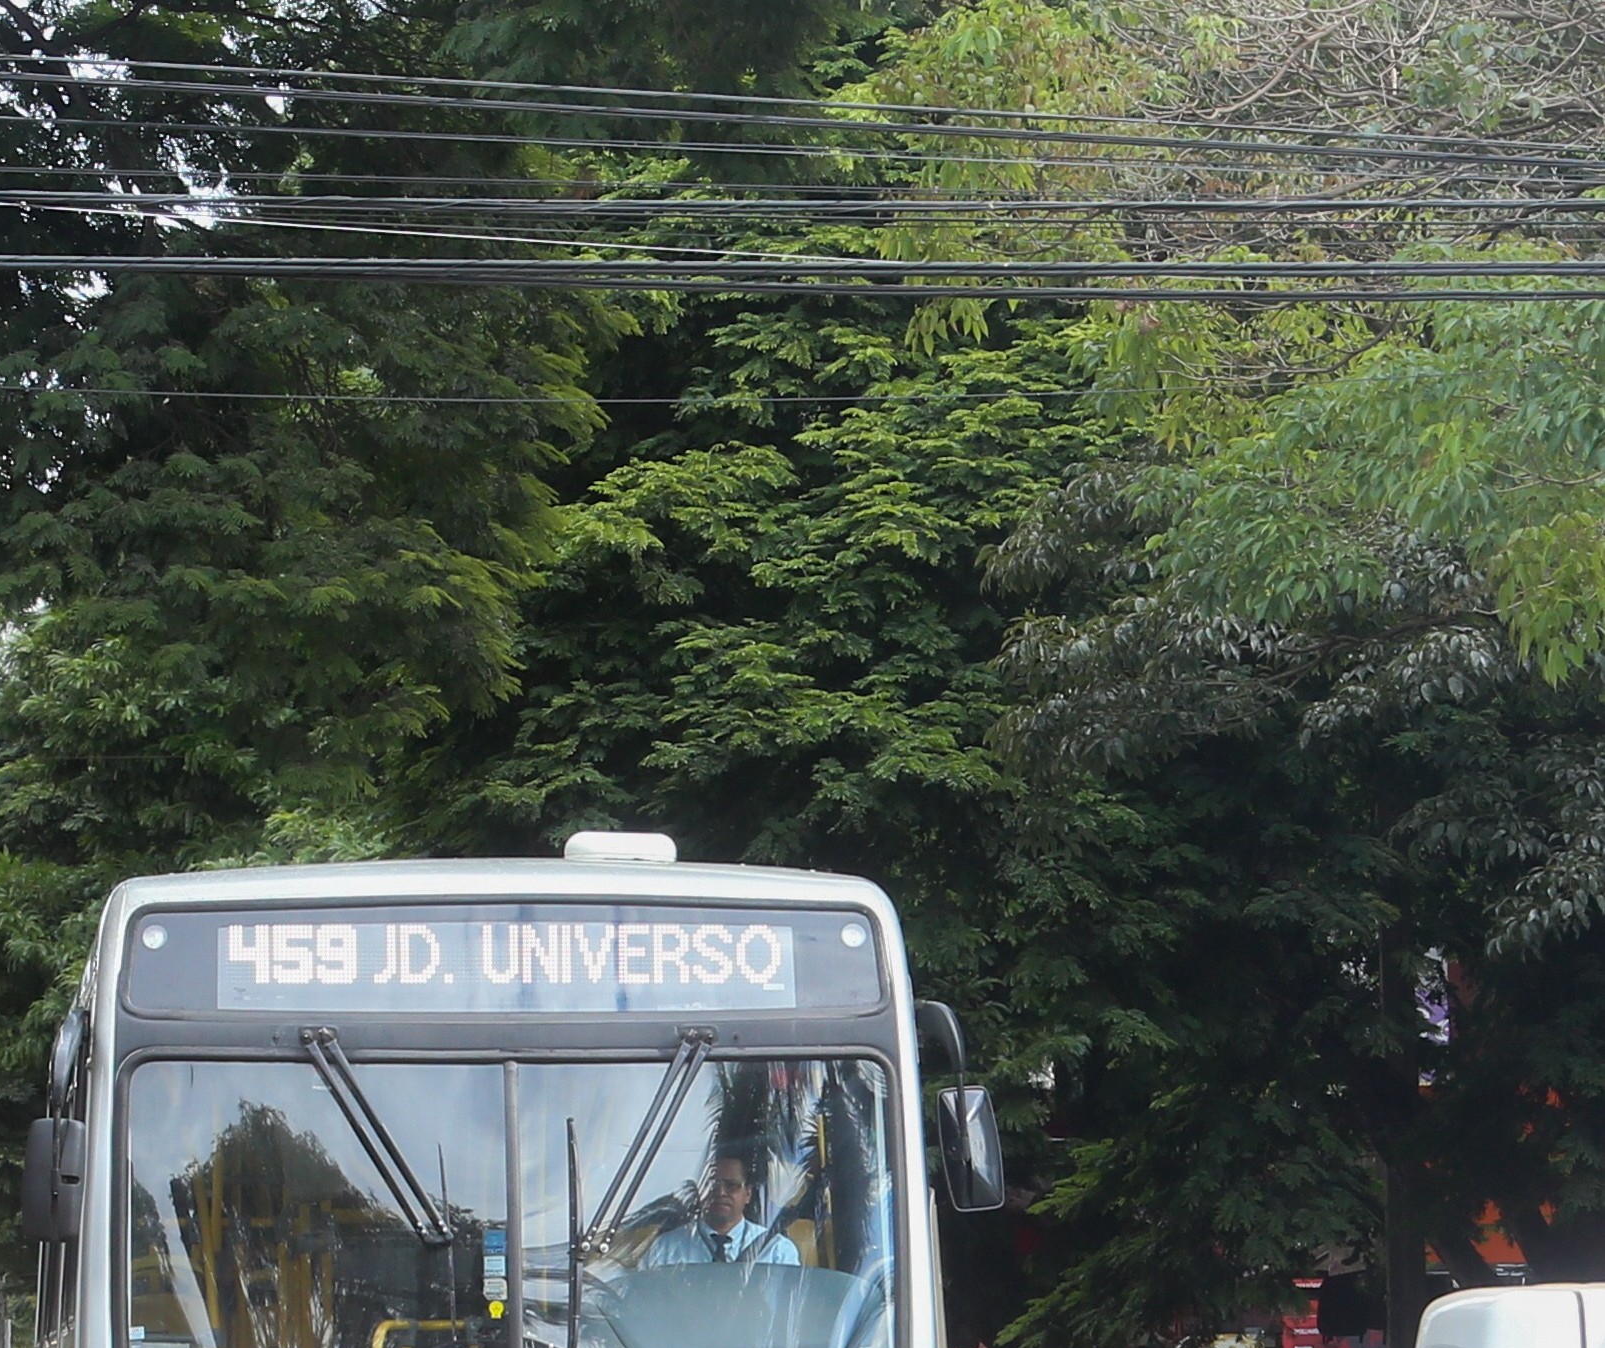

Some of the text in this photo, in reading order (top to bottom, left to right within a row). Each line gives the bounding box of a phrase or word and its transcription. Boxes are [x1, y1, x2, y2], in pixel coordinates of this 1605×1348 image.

[228, 924, 781, 984] 459 JD. UNIVERSO
